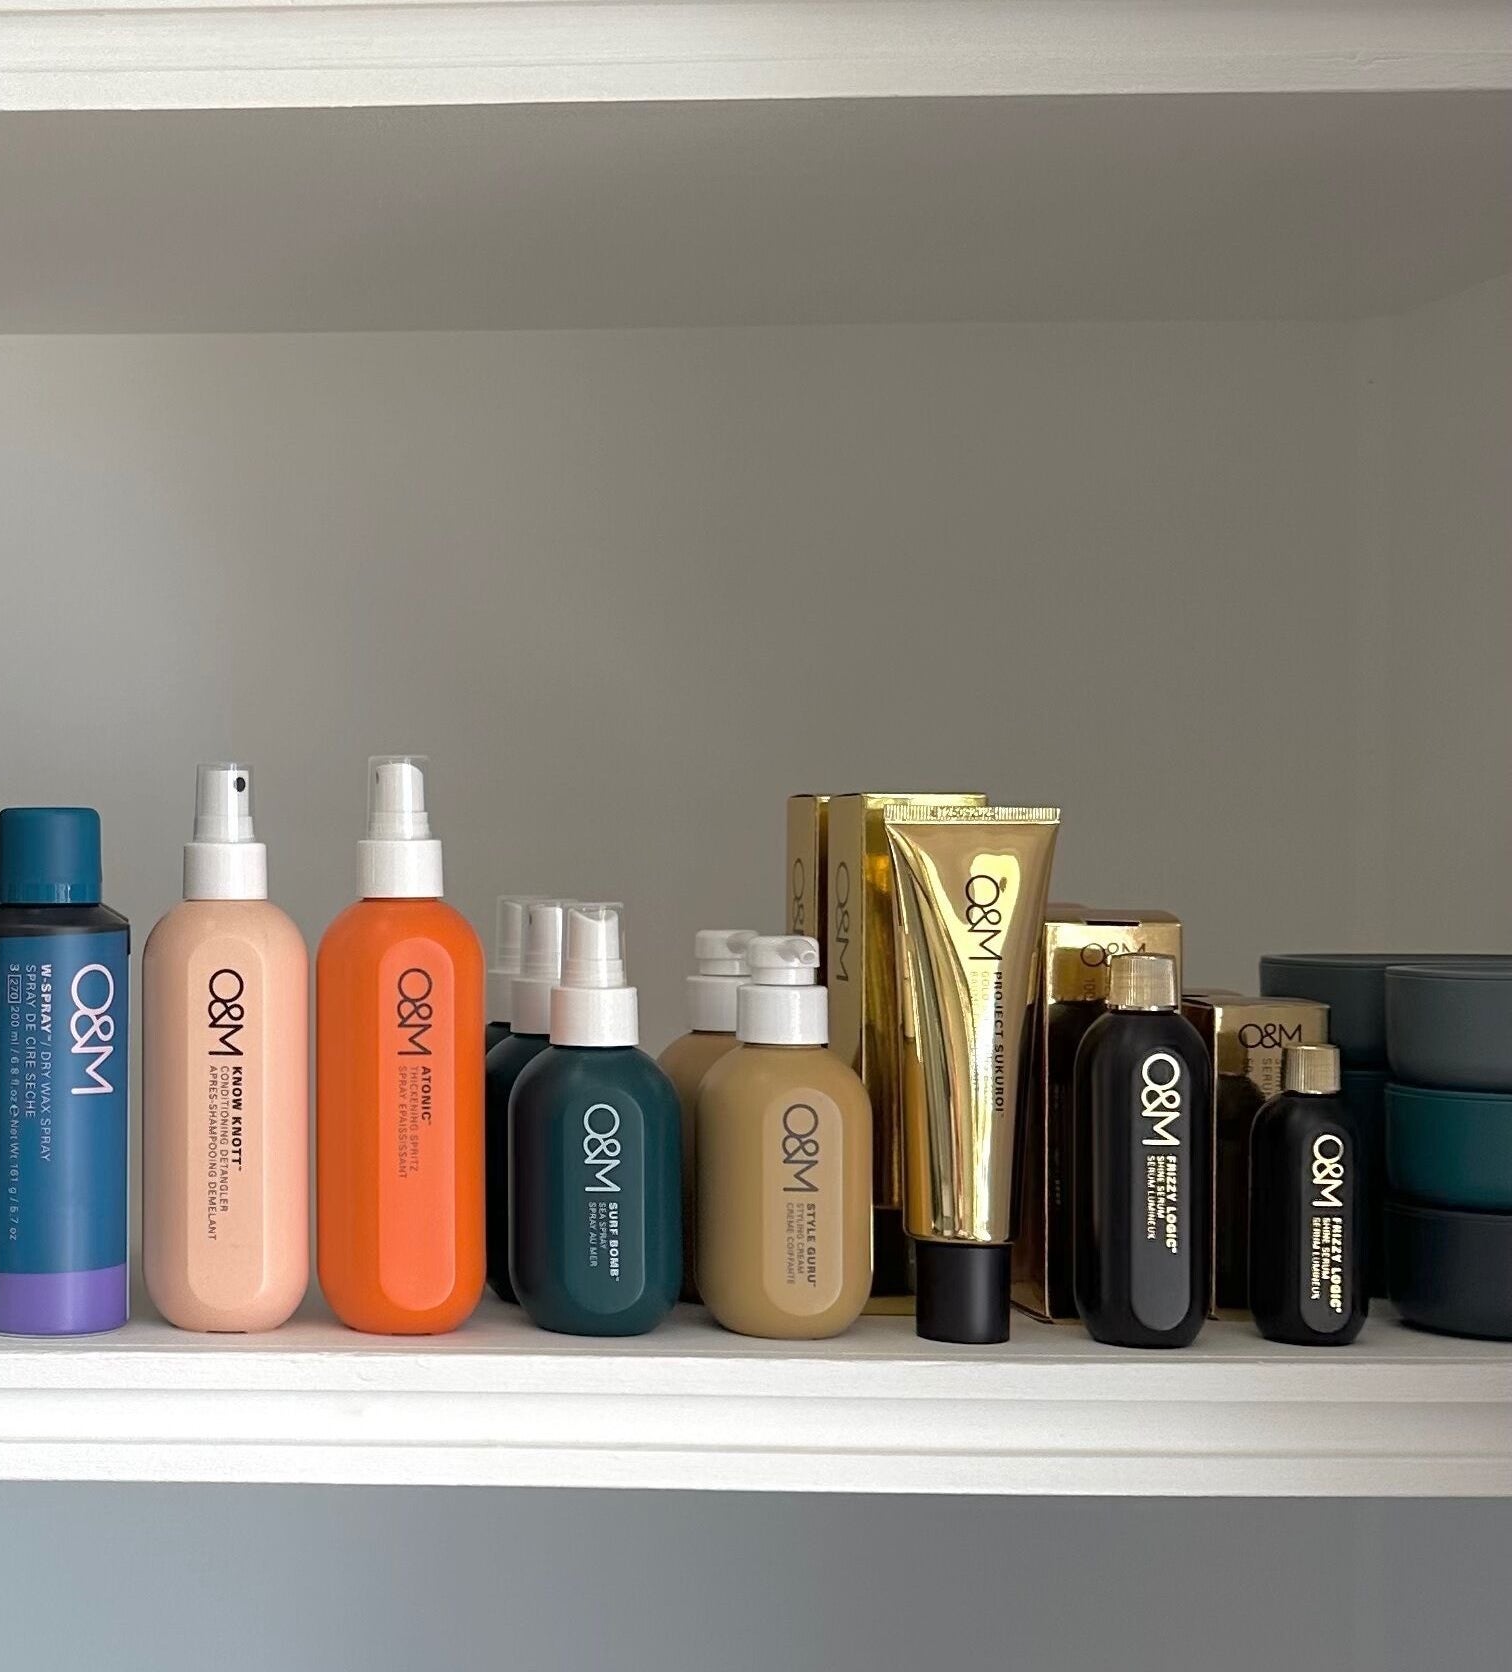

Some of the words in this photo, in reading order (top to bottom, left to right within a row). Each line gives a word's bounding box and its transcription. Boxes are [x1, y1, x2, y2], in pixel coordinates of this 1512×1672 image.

[792, 857, 805, 936] O&
[835, 861, 850, 982] O&M
[965, 875, 1003, 960] O&M
[25, 964, 36, 1008] SPRAY
[40, 964, 52, 1034] W-SPRAY
[10, 1006, 19, 1027] 200
[25, 1013, 36, 1032] DE
[70, 963, 115, 1095] O&M
[208, 968, 245, 1056] O&M
[397, 967, 433, 1056] O&M
[25, 1037, 36, 1069] CIRE
[1238, 1023, 1302, 1049] O&M
[40, 1051, 52, 1078] DRY
[399, 1065, 408, 1099] SPRAY
[40, 1082, 52, 1113] WAX
[220, 1066, 229, 1145] CONDITIONING
[232, 1066, 242, 1110] KNOW
[409, 1065, 419, 1131] THICKENING
[421, 1066, 432, 1121] ATONIC
[1141, 1053, 1181, 1145] O&M
[10, 1119, 19, 1139] Net
[40, 1118, 52, 1161] SPRAY
[583, 1103, 621, 1192] O&M
[782, 1103, 820, 1192] O&M
[409, 1134, 419, 1172] SPRITZ
[1312, 1134, 1345, 1207] O&M
[220, 1149, 229, 1212] DETANGLER
[1166, 1155, 1177, 1202] FRIZZY
[588, 1202, 597, 1229] SPRAY
[598, 1202, 607, 1219] SEA
[608, 1202, 620, 1236] SURF
[796, 1202, 805, 1239] STYLING
[1157, 1186, 1165, 1218] SERUM
[588, 1231, 597, 1244] AU
[598, 1222, 607, 1249] SPRAY
[807, 1203, 816, 1243] STYLE
[1331, 1217, 1343, 1262] FRIZZY
[588, 1247, 597, 1267] MER
[608, 1239, 620, 1277] BOMB
[796, 1242, 805, 1274] CREAM
[807, 1247, 816, 1283] GURU
